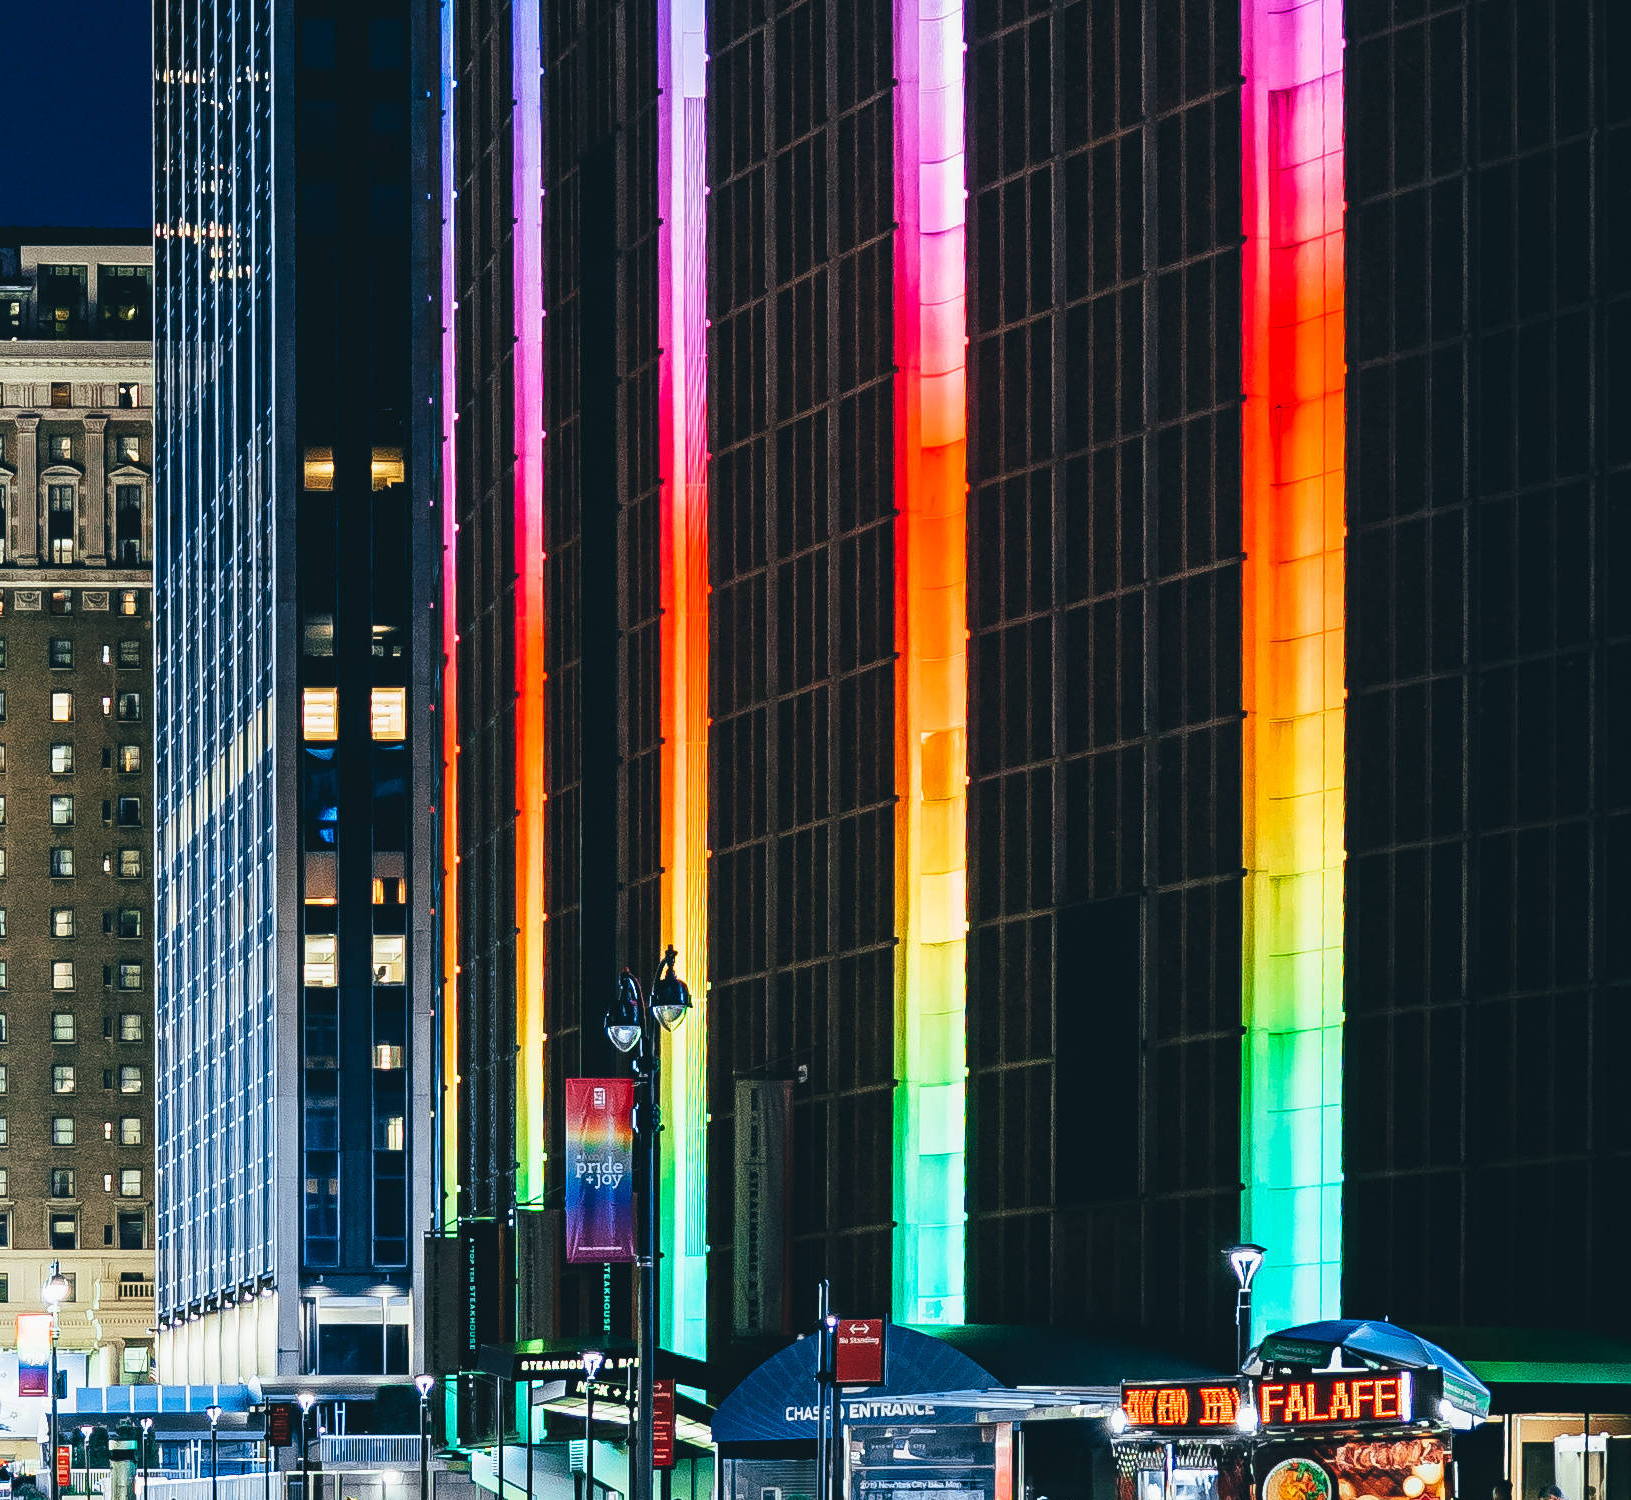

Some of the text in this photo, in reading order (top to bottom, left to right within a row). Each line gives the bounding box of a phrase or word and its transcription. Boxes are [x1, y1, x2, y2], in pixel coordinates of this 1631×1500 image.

[575, 1156, 624, 1178] pride
[575, 1380, 609, 1397] NCK
[849, 1402, 936, 1419] ENTRANCE
